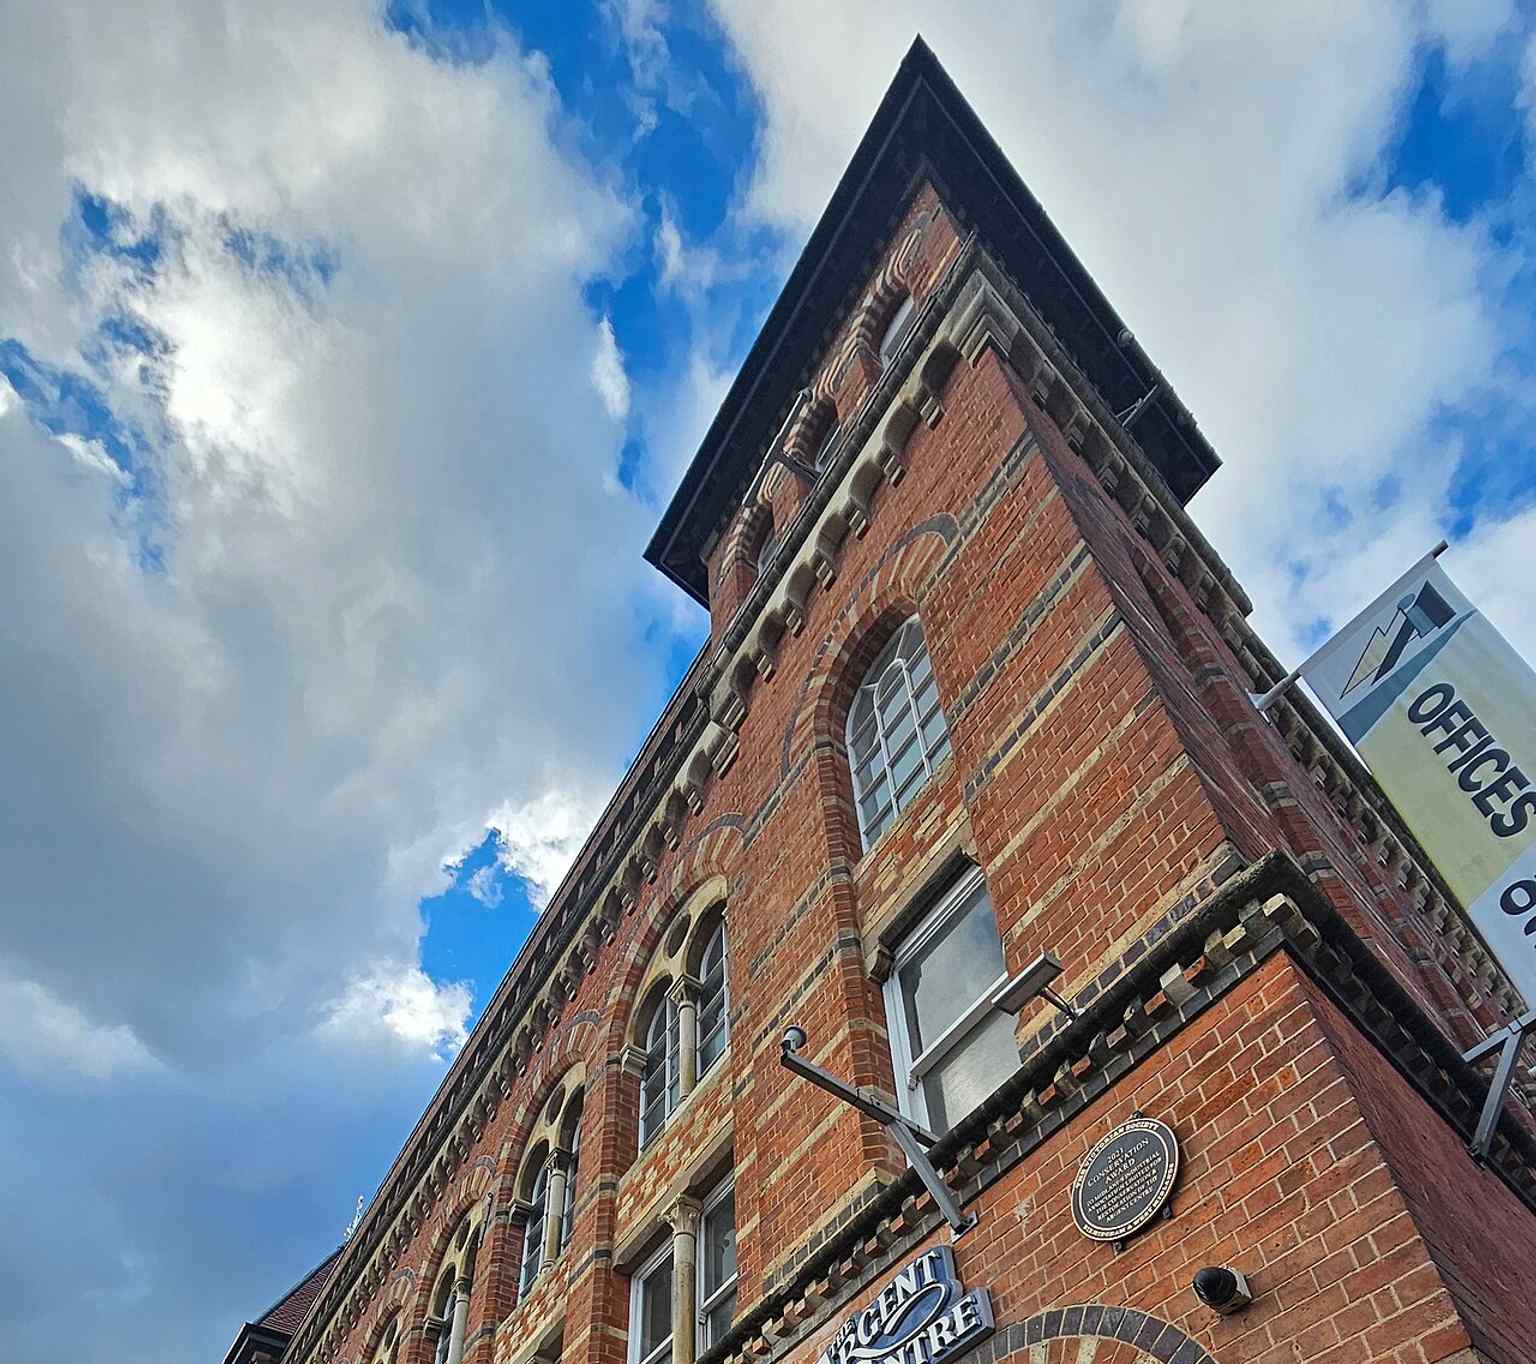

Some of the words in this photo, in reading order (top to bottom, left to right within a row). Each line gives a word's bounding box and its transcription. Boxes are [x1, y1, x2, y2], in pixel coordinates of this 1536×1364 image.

[1408, 683, 1536, 838] OFFICES
[1088, 1137, 1149, 1187] CONSERVATION
[1105, 1158, 1135, 1184] AWARD
[830, 1318, 856, 1357] THE
